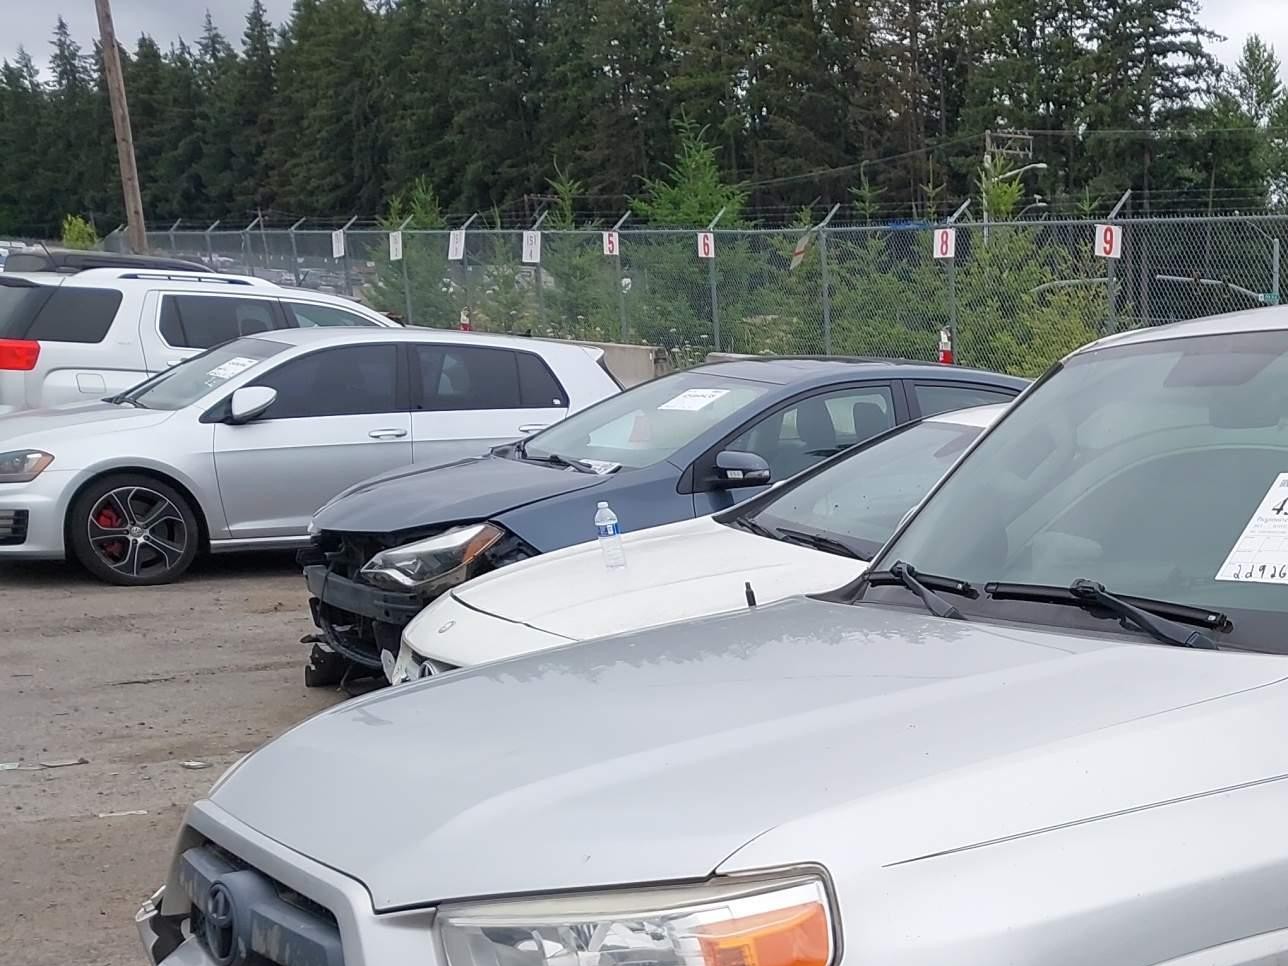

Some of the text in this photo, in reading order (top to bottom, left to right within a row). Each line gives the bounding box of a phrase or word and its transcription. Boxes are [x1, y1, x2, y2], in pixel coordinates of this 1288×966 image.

[607, 232, 615, 253] 5
[702, 234, 711, 256] 6
[939, 230, 949, 256] 8
[1103, 227, 1114, 255] 9
